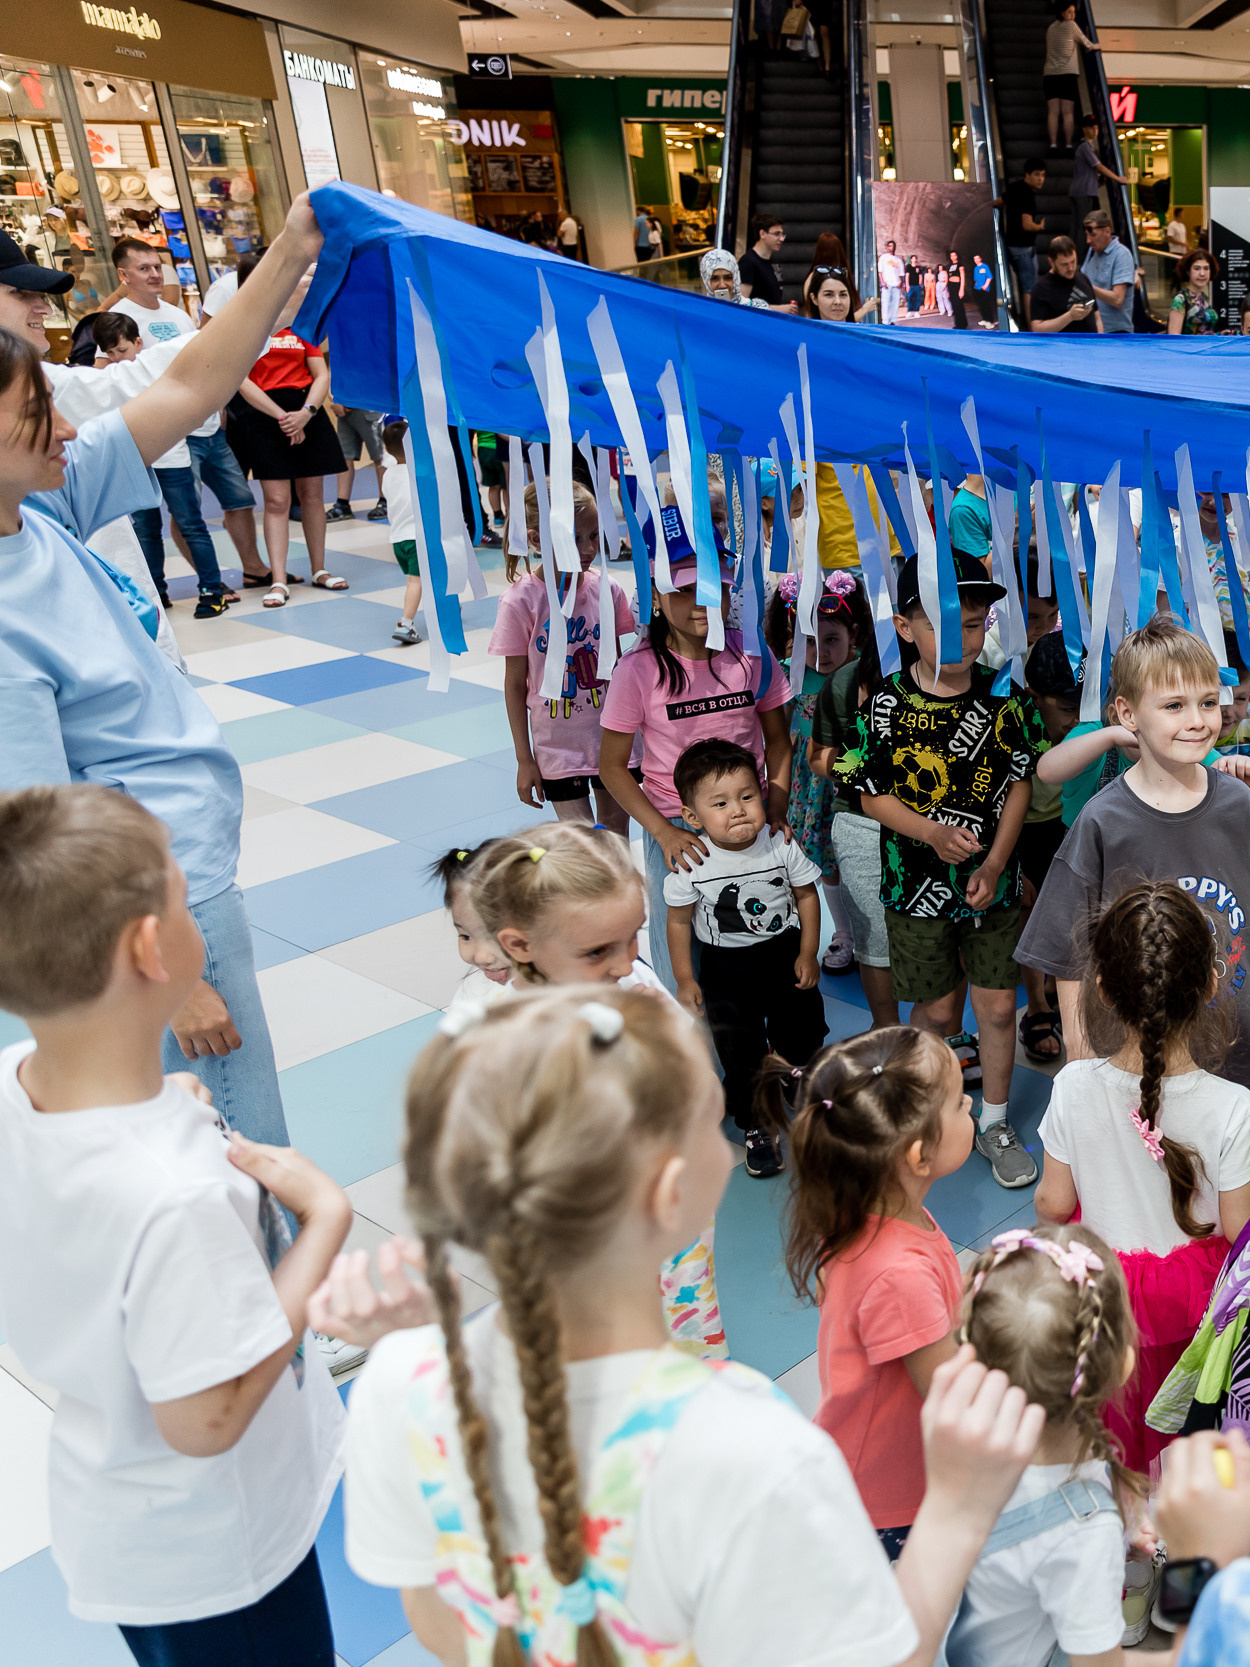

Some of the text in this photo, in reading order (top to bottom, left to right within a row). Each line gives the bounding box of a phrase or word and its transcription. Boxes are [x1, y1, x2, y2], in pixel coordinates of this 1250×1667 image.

[283, 50, 356, 90] БАНКОМАТЫ
[1219, 249, 1227, 259] 4
[1219, 281, 1227, 291] 3
[1219, 308, 1227, 318] 2
[661, 508, 682, 542] SIBIR
[708, 700, 718, 710] В
[719, 695, 749, 707] ОТЦА
[948, 699, 993, 758] STAR!
[1177, 875, 1246, 935] PPY'S
